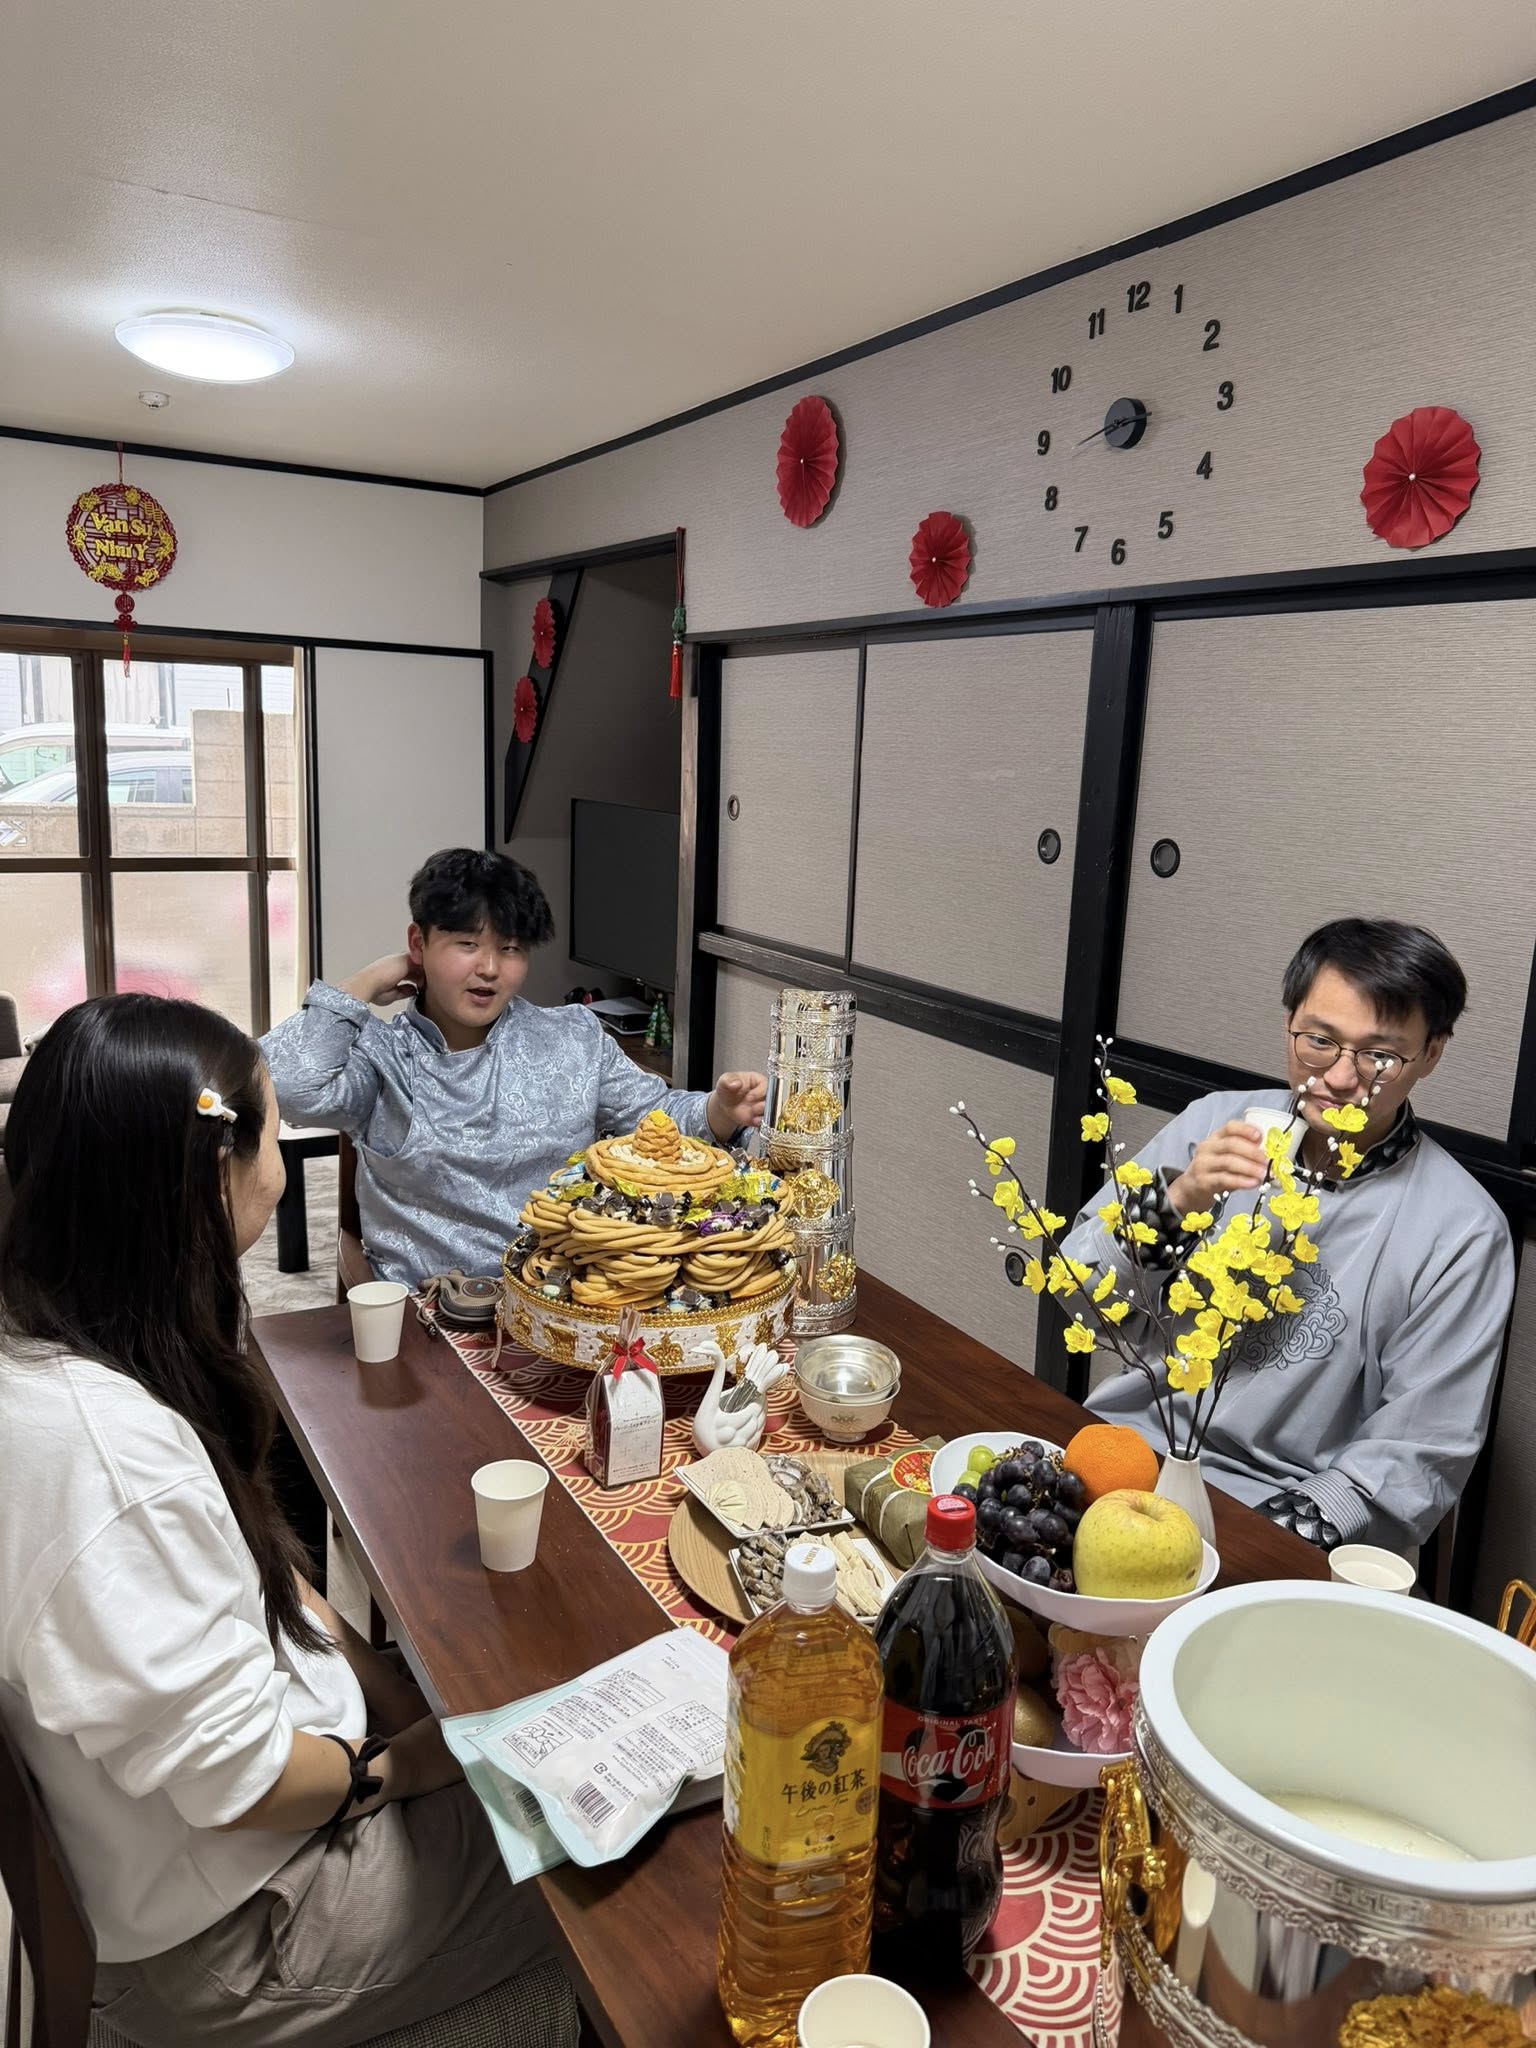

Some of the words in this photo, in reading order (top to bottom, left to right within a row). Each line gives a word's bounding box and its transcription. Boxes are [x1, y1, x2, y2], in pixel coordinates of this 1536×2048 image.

[1127, 281, 1151, 312] 12
[1174, 284, 1184, 313] 1
[1088, 308, 1105, 339] 11
[1203, 319, 1221, 351] 2
[1051, 365, 1071, 393] 10
[1217, 381, 1234, 410] 3
[1037, 430, 1050, 455] 9
[1196, 451, 1213, 479] 4
[1045, 486, 1058, 511] 8
[91, 512, 129, 538] Vạn
[1074, 526, 1088, 552] 7
[1158, 511, 1173, 539] 5
[1111, 539, 1125, 565] 6
[782, 1768, 867, 1804] 午後の紅茶
